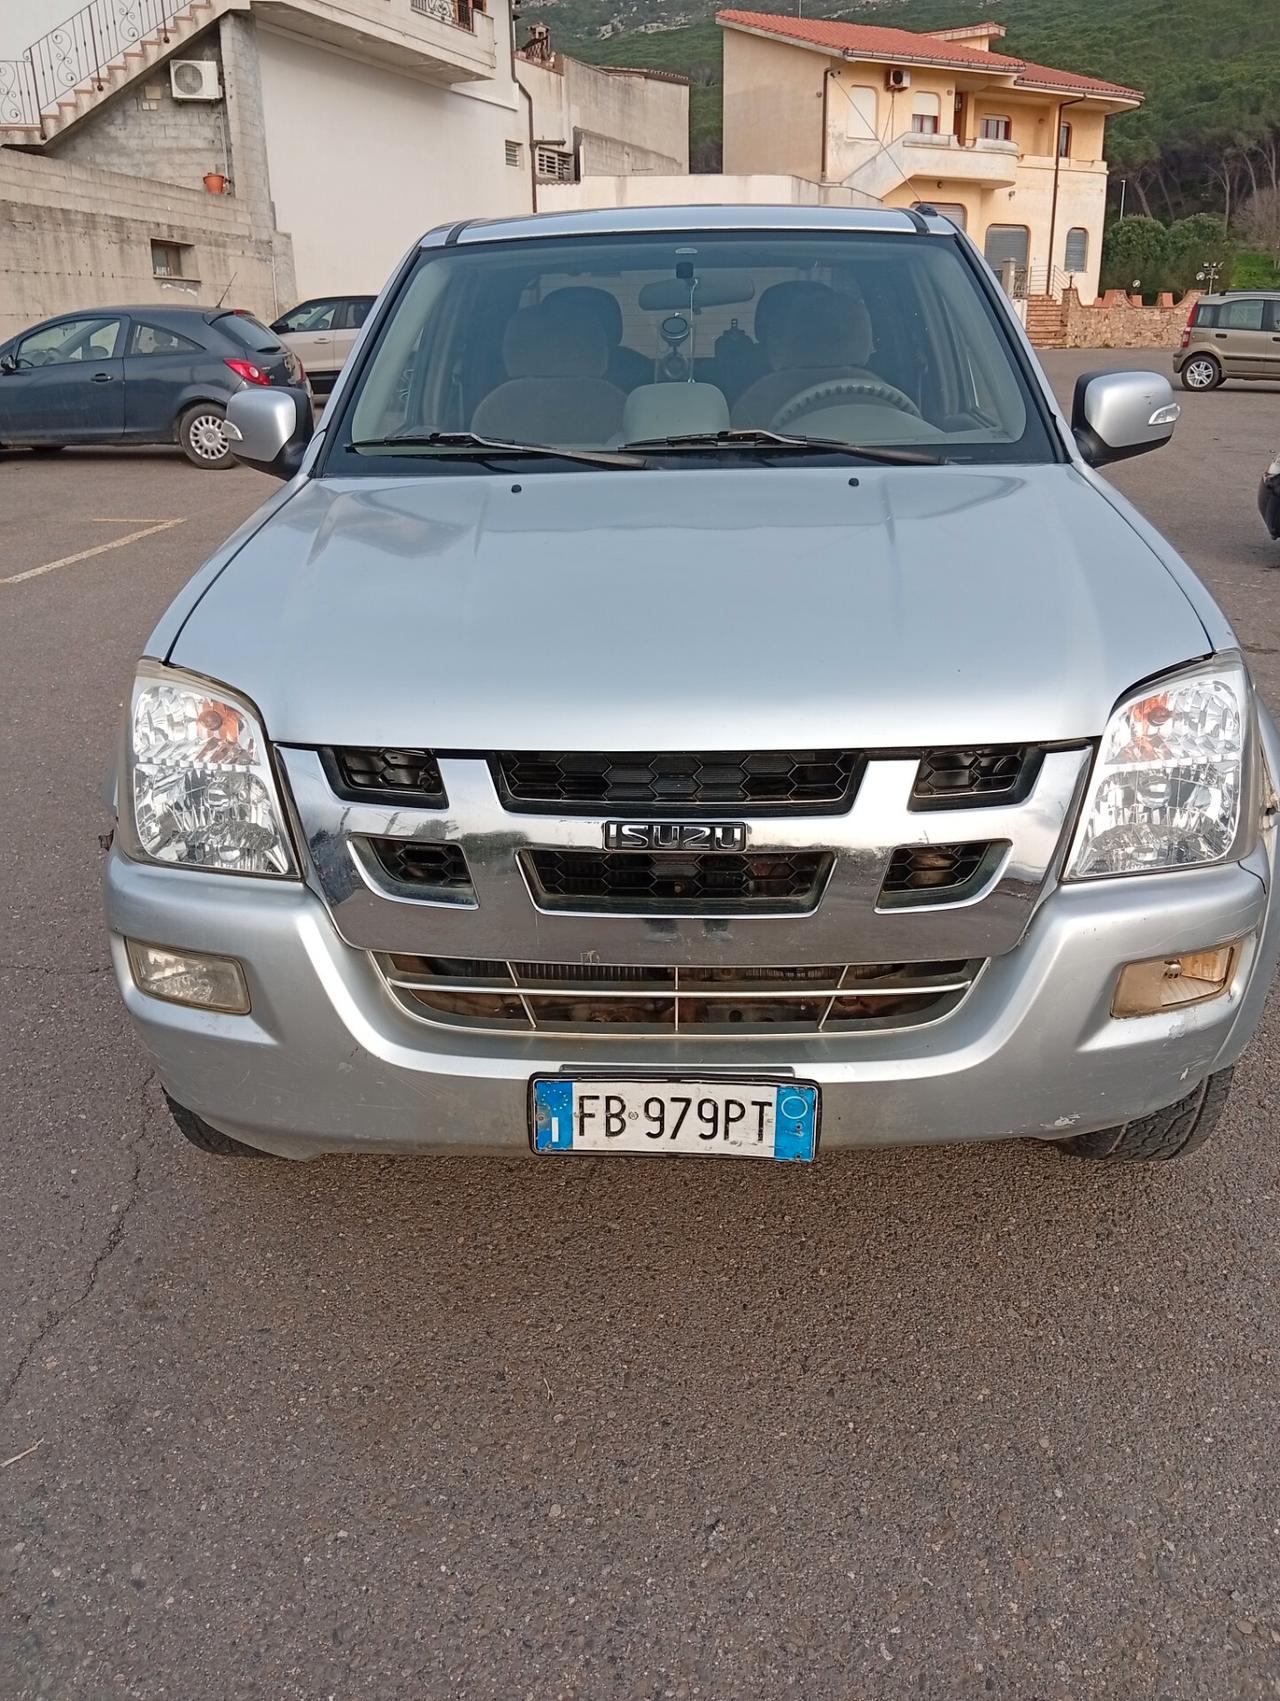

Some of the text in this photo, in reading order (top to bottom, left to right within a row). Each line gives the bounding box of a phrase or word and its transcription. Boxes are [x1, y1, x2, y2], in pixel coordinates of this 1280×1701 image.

[609, 824, 742, 850] ISUZU
[551, 1117, 559, 1142] I
[578, 1095, 773, 1144] FB 979PT
